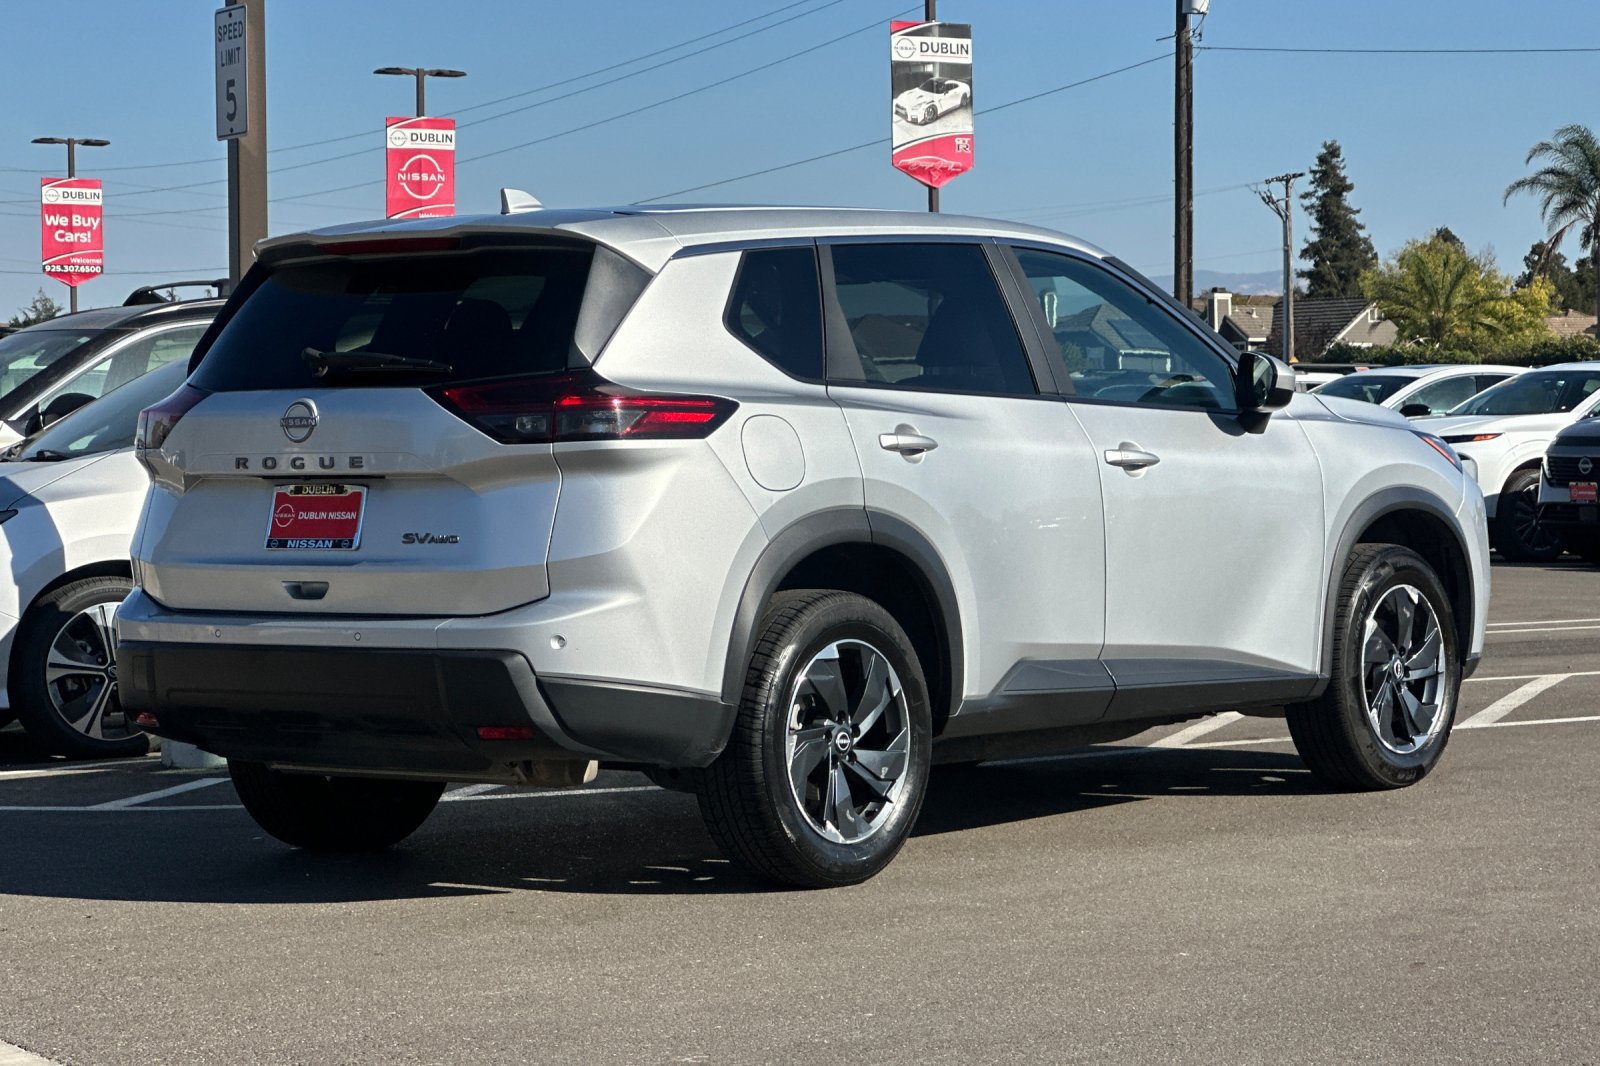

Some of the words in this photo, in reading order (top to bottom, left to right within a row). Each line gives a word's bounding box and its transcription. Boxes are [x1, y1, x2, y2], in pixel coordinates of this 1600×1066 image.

[218, 21, 243, 42] SPEED
[920, 41, 969, 55] DUBLIN
[221, 47, 240, 67] LIMIT
[226, 79, 237, 121] 5
[410, 132, 453, 143] DUBLIN
[397, 172, 445, 182] NISSAN
[62, 190, 100, 200] DUBLIN
[44, 213, 69, 226] We
[72, 214, 100, 230] Buy
[54, 229, 92, 243] Cars!
[44, 265, 101, 273] 925.307.6500
[281, 417, 318, 427] NISSAN
[235, 456, 364, 470] ROGUE
[302, 485, 336, 494] DUBLIN
[298, 511, 327, 520] DUBLIN
[328, 511, 357, 520] NISSAN
[286, 539, 333, 548] NISSAN
[402, 532, 431, 544] SV
